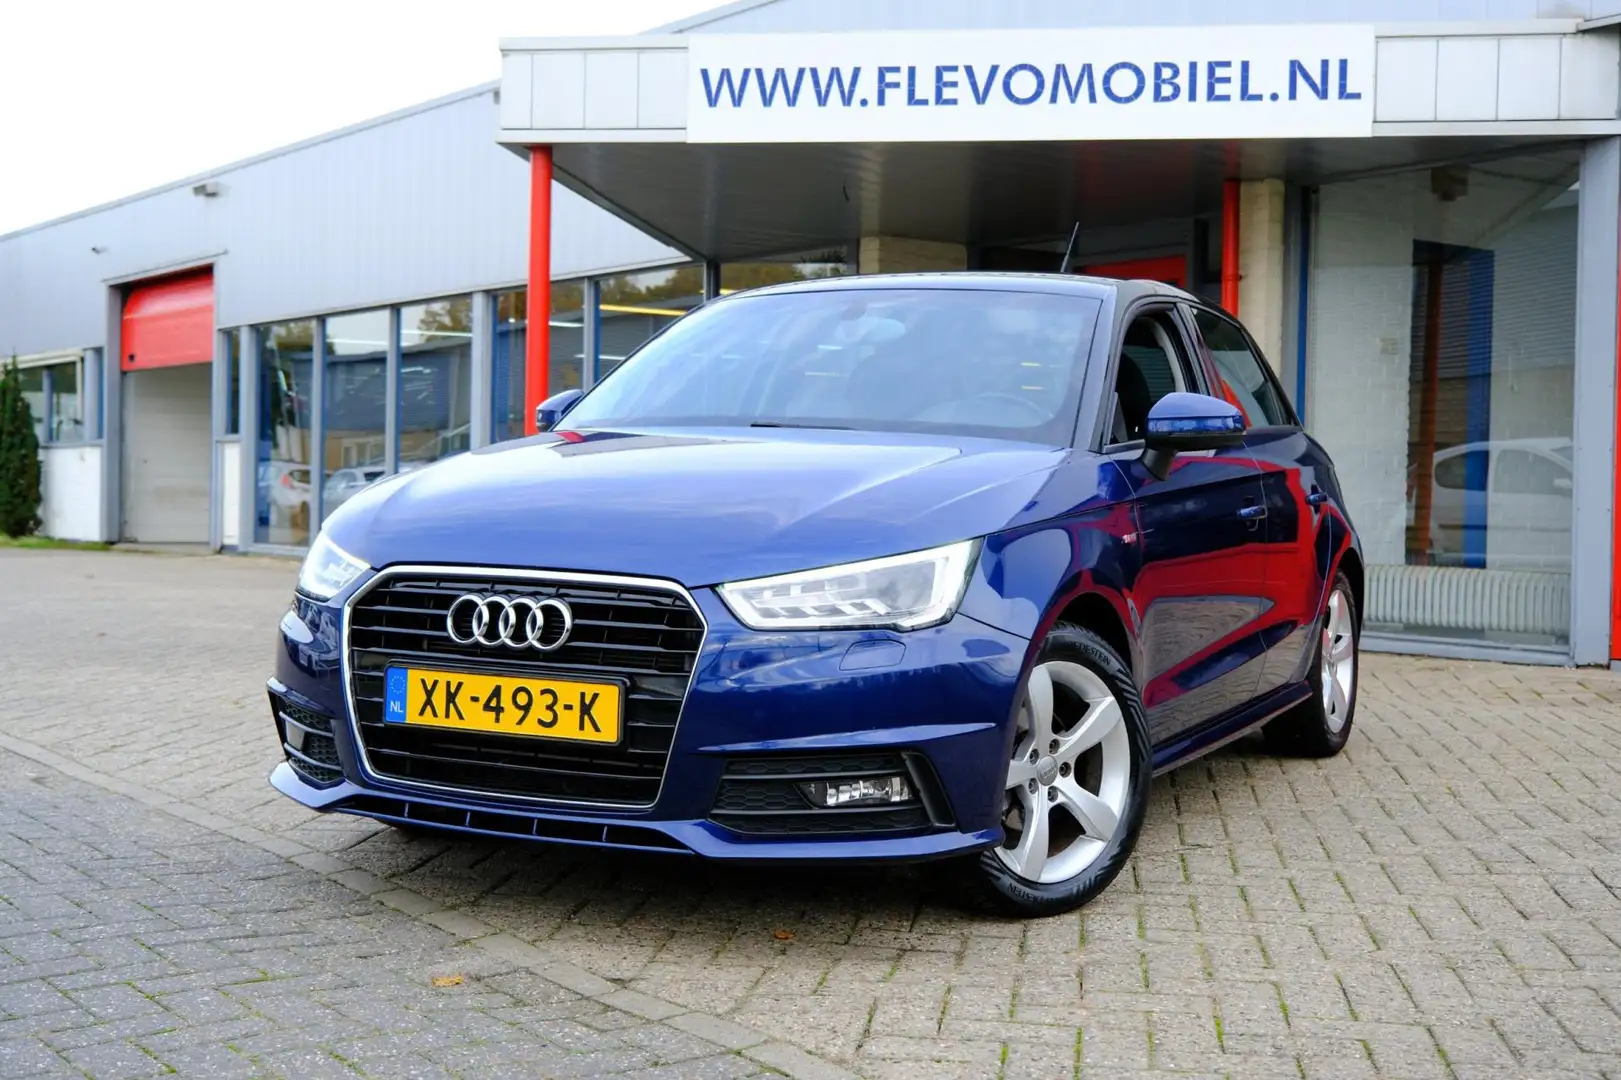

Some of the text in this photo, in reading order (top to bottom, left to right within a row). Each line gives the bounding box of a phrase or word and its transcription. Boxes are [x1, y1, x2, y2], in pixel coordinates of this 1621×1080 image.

[700, 58, 1362, 108] WWW.FLEVOMOBIEL.NL
[390, 700, 404, 713] NL
[418, 677, 602, 733] XK-493-K
